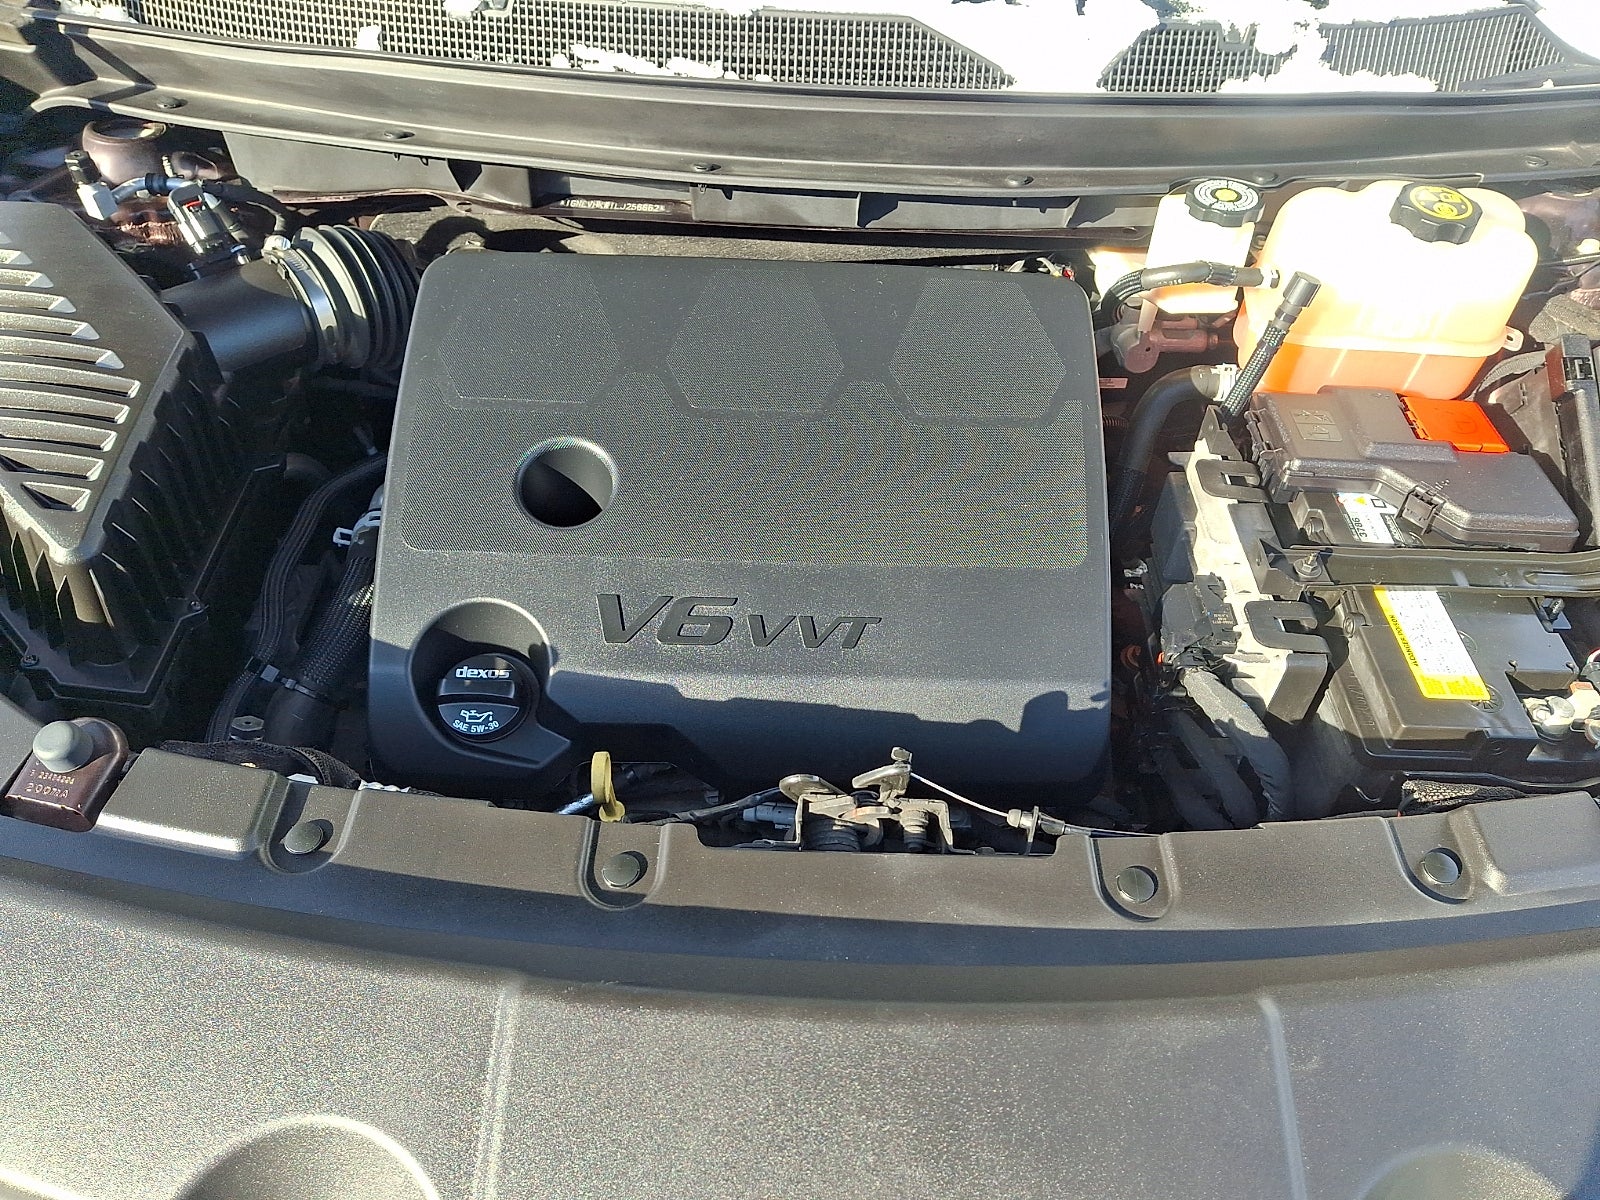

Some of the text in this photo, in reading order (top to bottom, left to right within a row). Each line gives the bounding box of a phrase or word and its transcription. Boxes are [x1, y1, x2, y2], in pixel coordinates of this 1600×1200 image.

[596, 593, 882, 649] V6 VVT
[455, 666, 511, 679] dexos
[453, 720, 499, 733] SAE 5W-30
